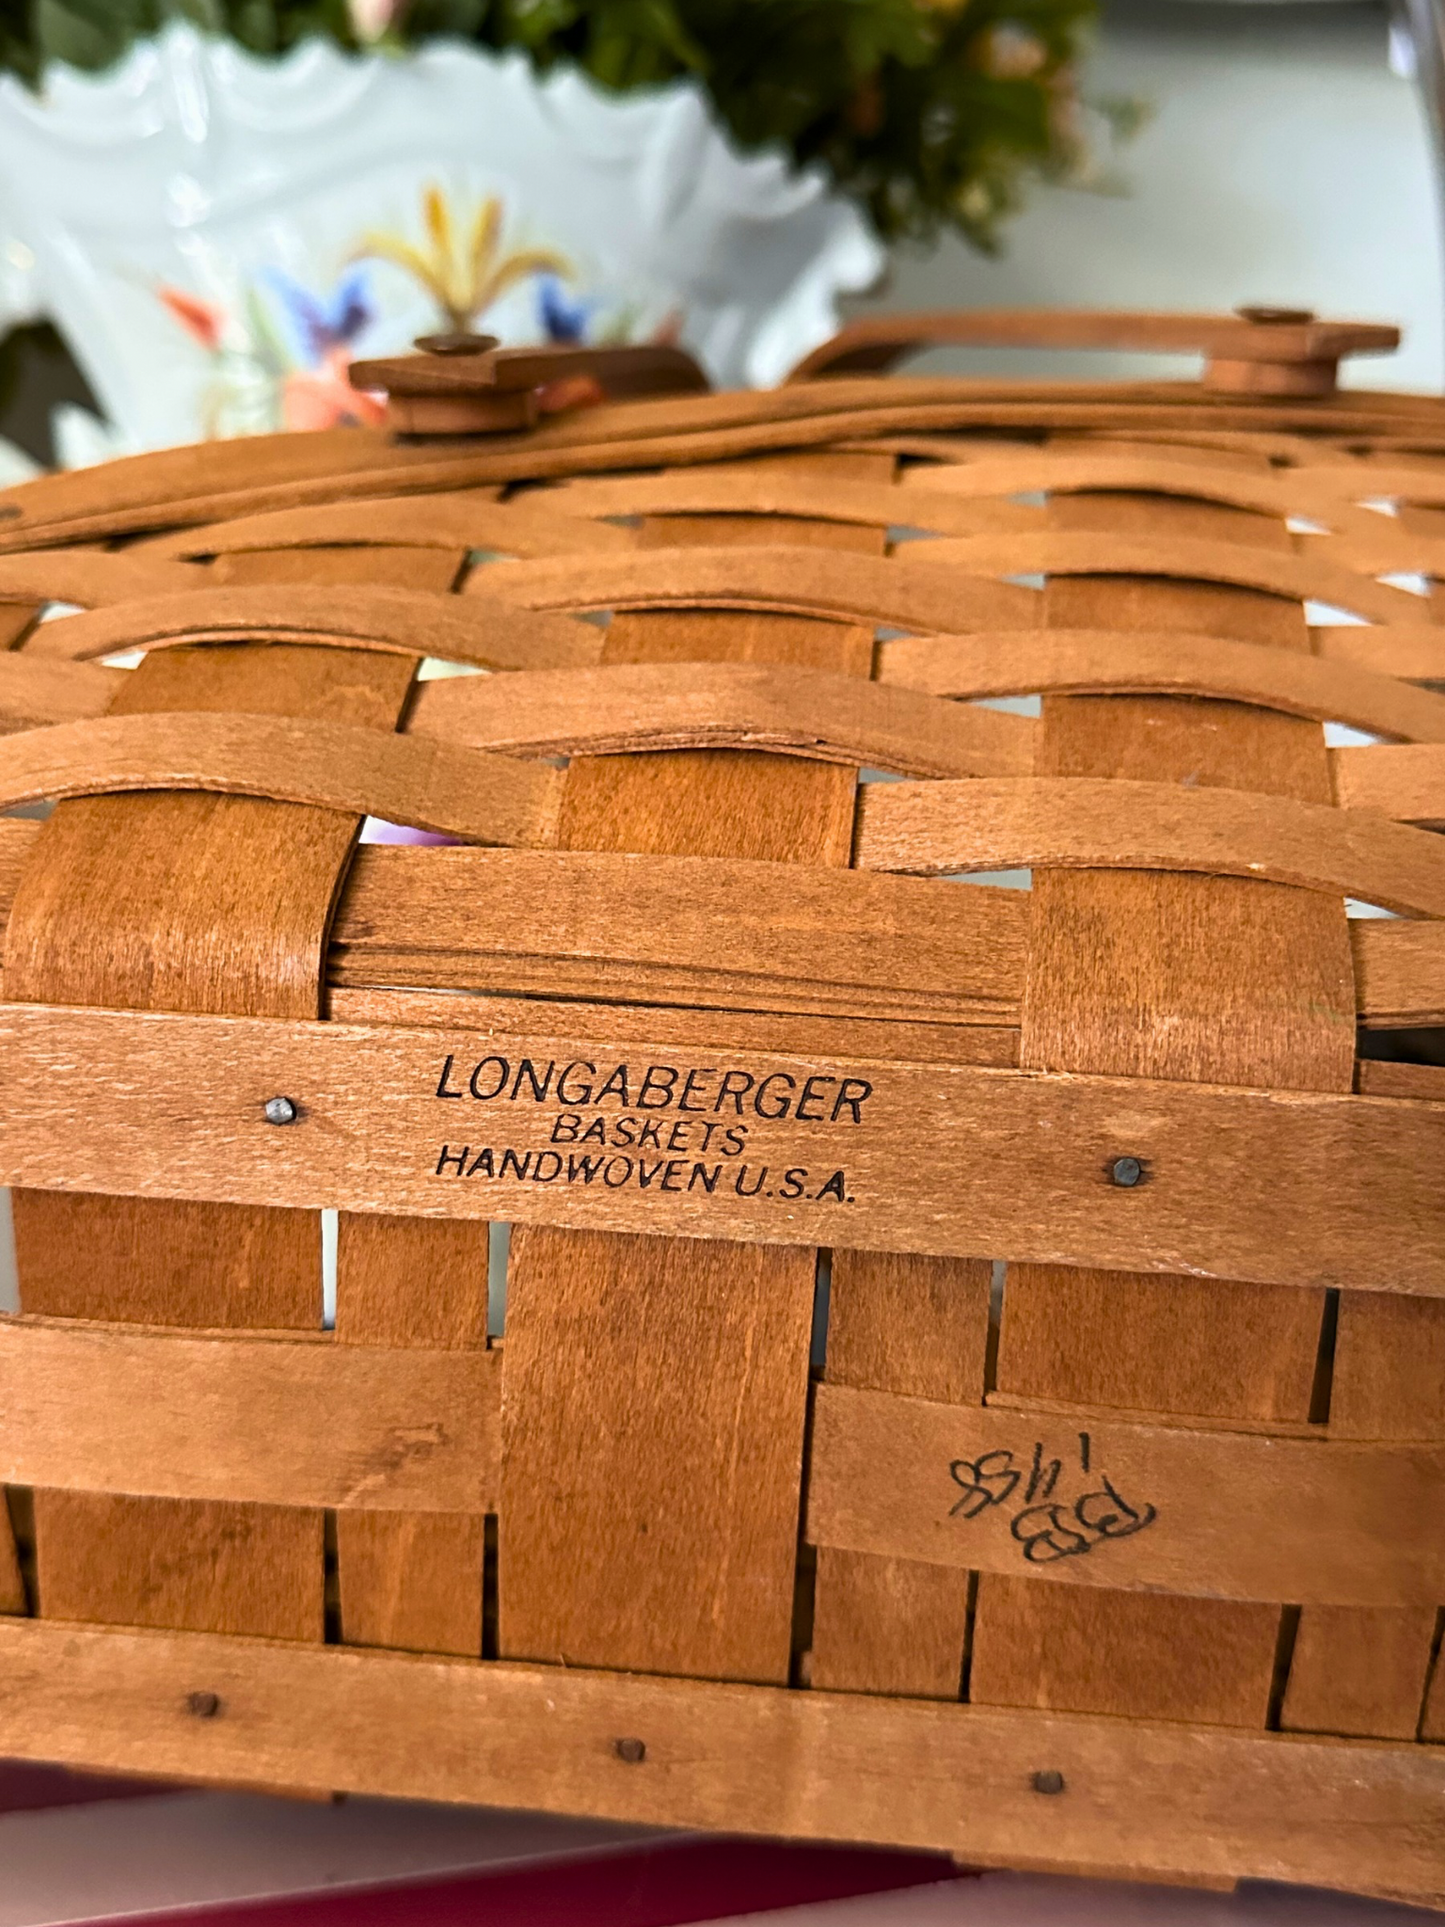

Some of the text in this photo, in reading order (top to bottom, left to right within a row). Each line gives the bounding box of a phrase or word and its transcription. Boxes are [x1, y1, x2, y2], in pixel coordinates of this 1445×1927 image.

[435, 1054, 874, 1124] LONGABERGER
[550, 1113, 750, 1156] BASKETS
[435, 1145, 857, 1203] HANDWOVEN U.S.A.
